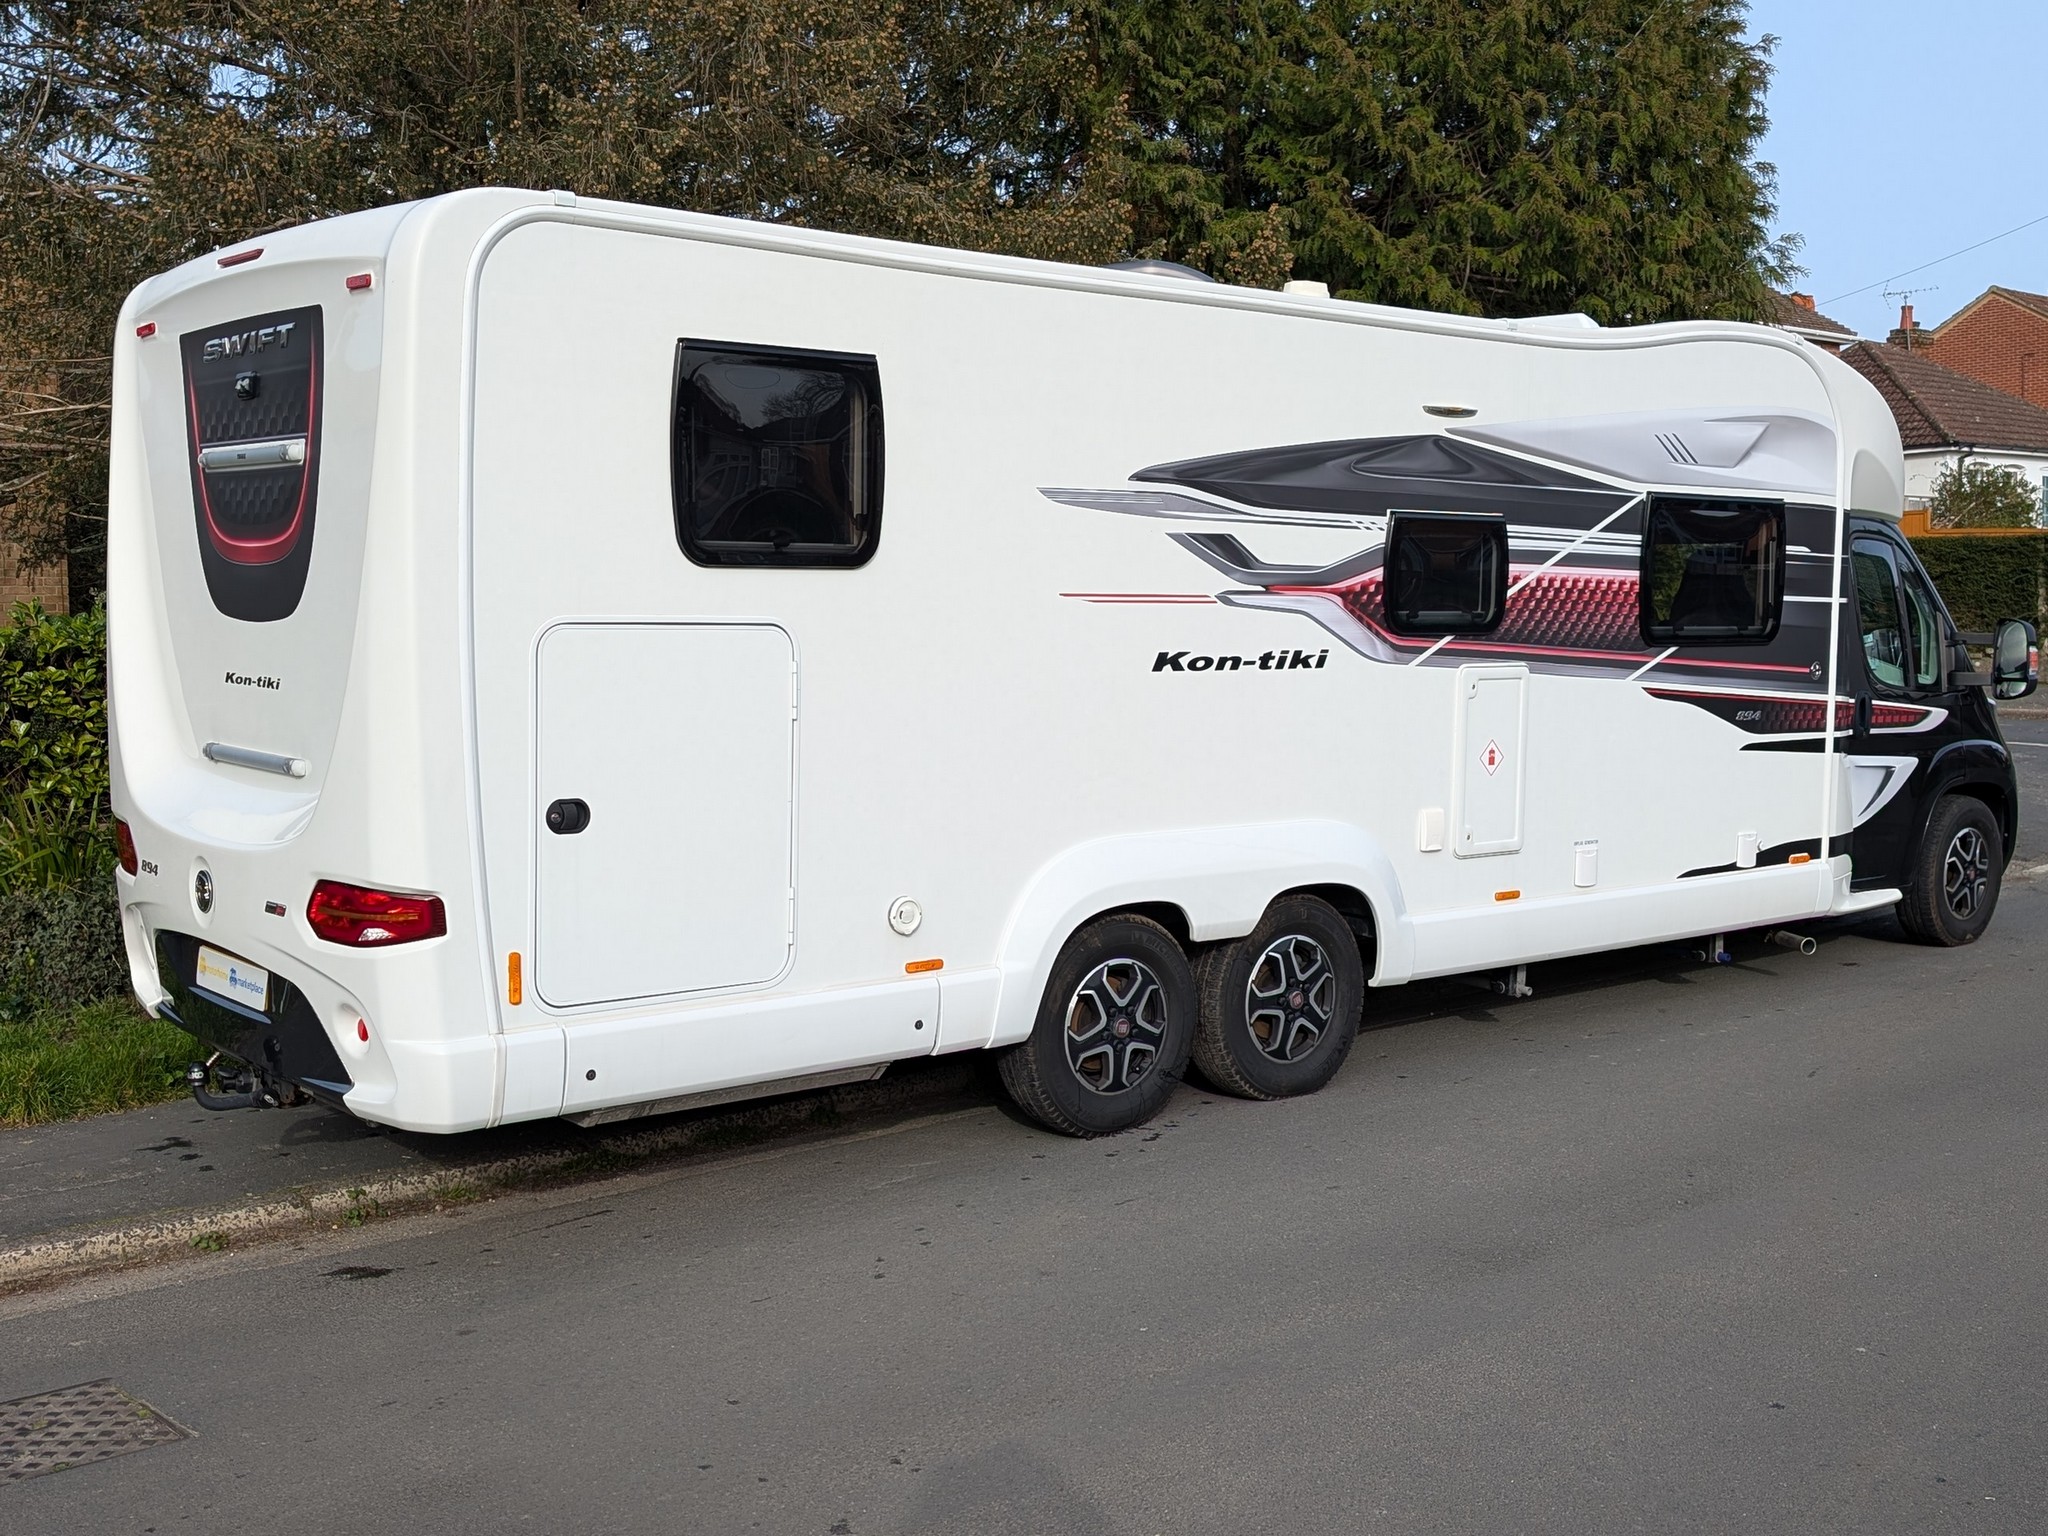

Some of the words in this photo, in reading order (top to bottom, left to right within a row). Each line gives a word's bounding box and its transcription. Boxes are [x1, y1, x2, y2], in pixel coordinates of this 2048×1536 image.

[203, 322, 296, 364] SWIFT
[1151, 649, 1330, 672] Kon-tiki
[225, 672, 281, 690] Kon-tiki
[1735, 710, 1762, 721] 894
[141, 859, 159, 876] 894
[237, 977, 264, 995] marketplace
